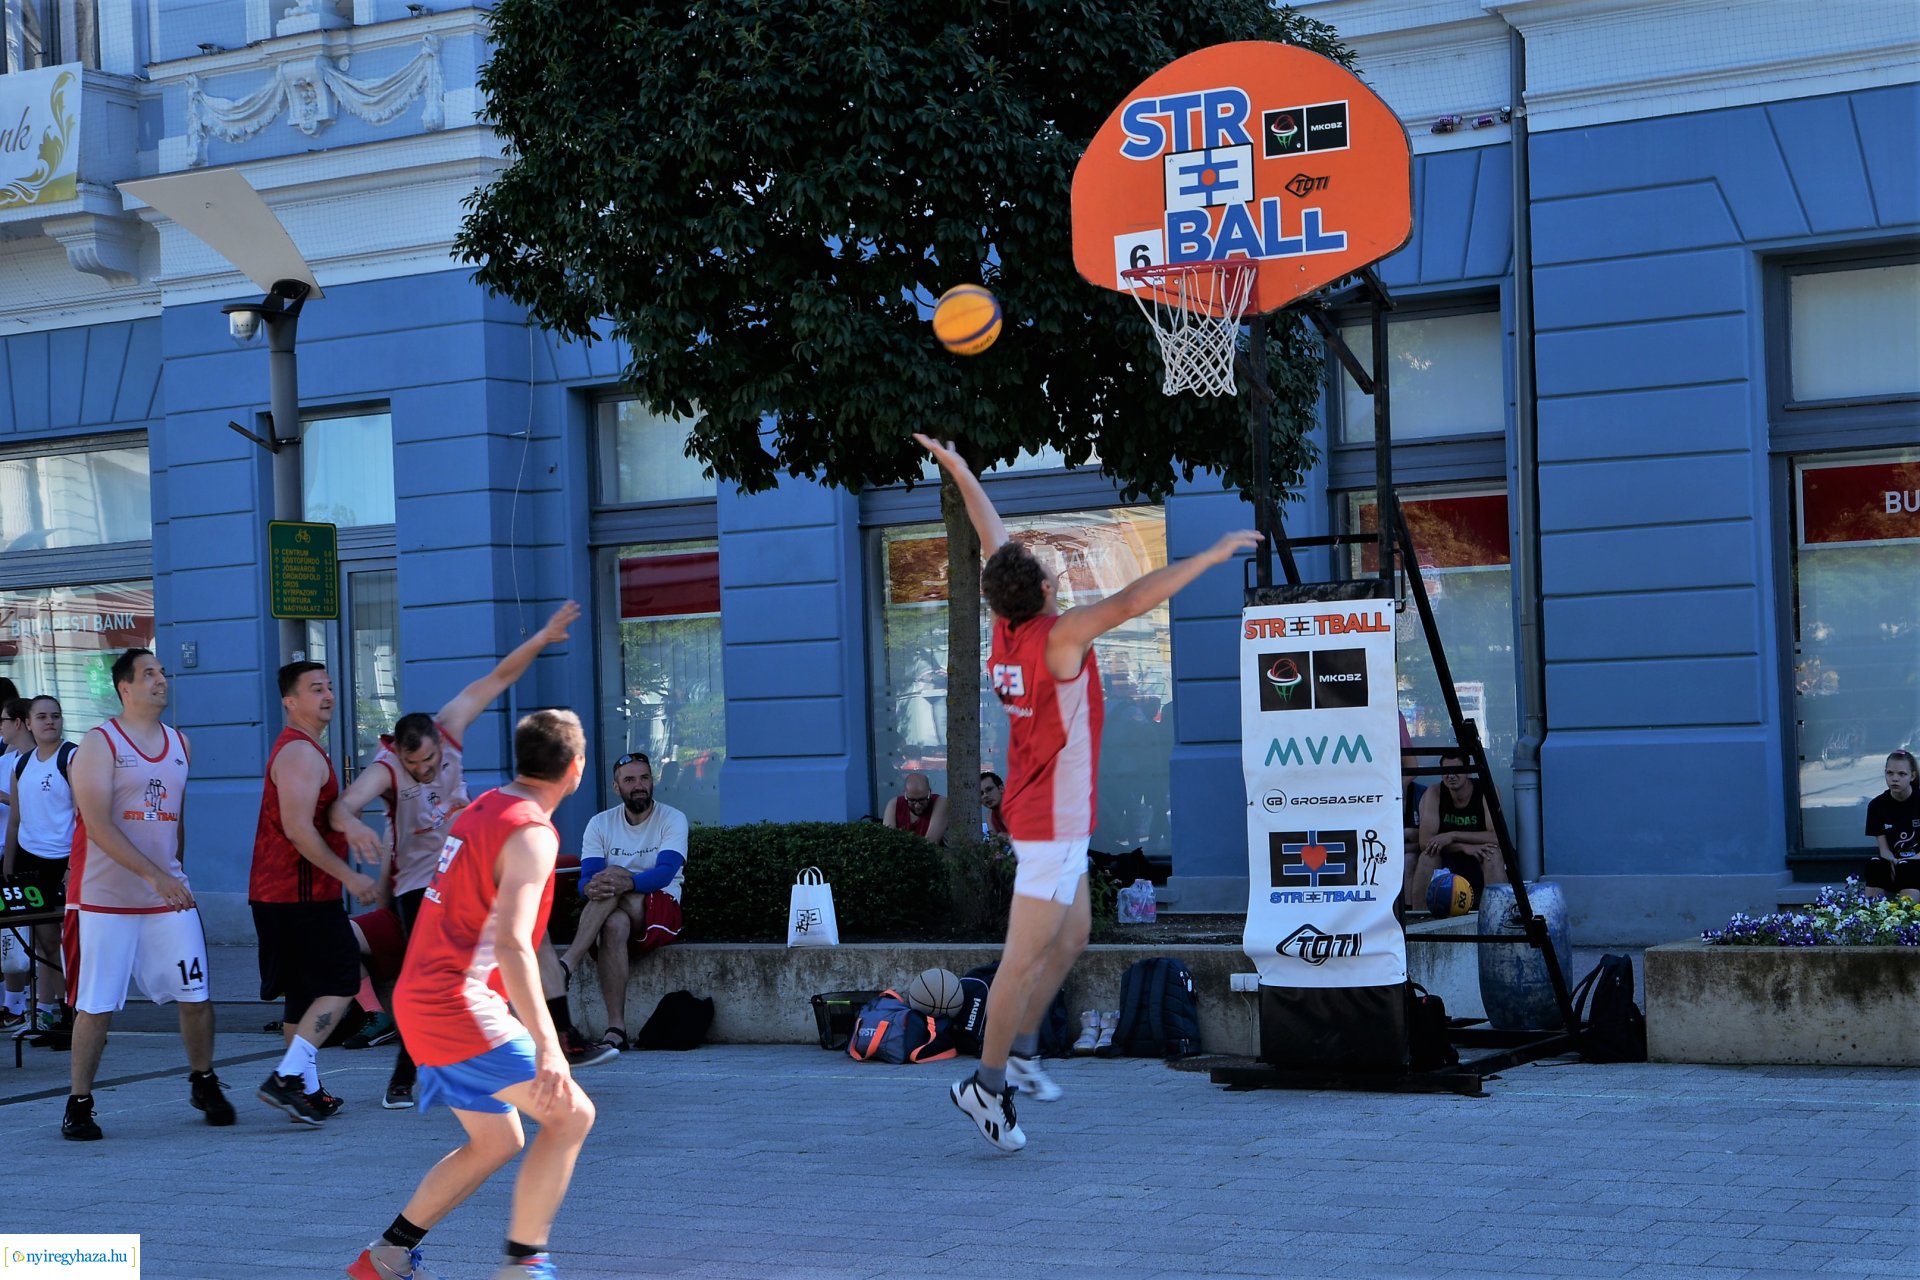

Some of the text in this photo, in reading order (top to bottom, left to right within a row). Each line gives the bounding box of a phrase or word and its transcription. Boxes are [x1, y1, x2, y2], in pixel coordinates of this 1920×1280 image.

[1311, 121, 1343, 132] MKOSZ
[1295, 175, 1330, 193] TOTI
[1165, 197, 1347, 265] BALL
[1885, 489, 1920, 514] BU
[93, 612, 136, 632] BANK
[1319, 673, 1362, 683] MKOSZ
[1264, 734, 1373, 767] MVM
[1266, 794, 1384, 806] GB GROSBASKET
[24, 886, 44, 907] 9
[1295, 932, 1363, 960] TOTI
[177, 957, 203, 985] 14
